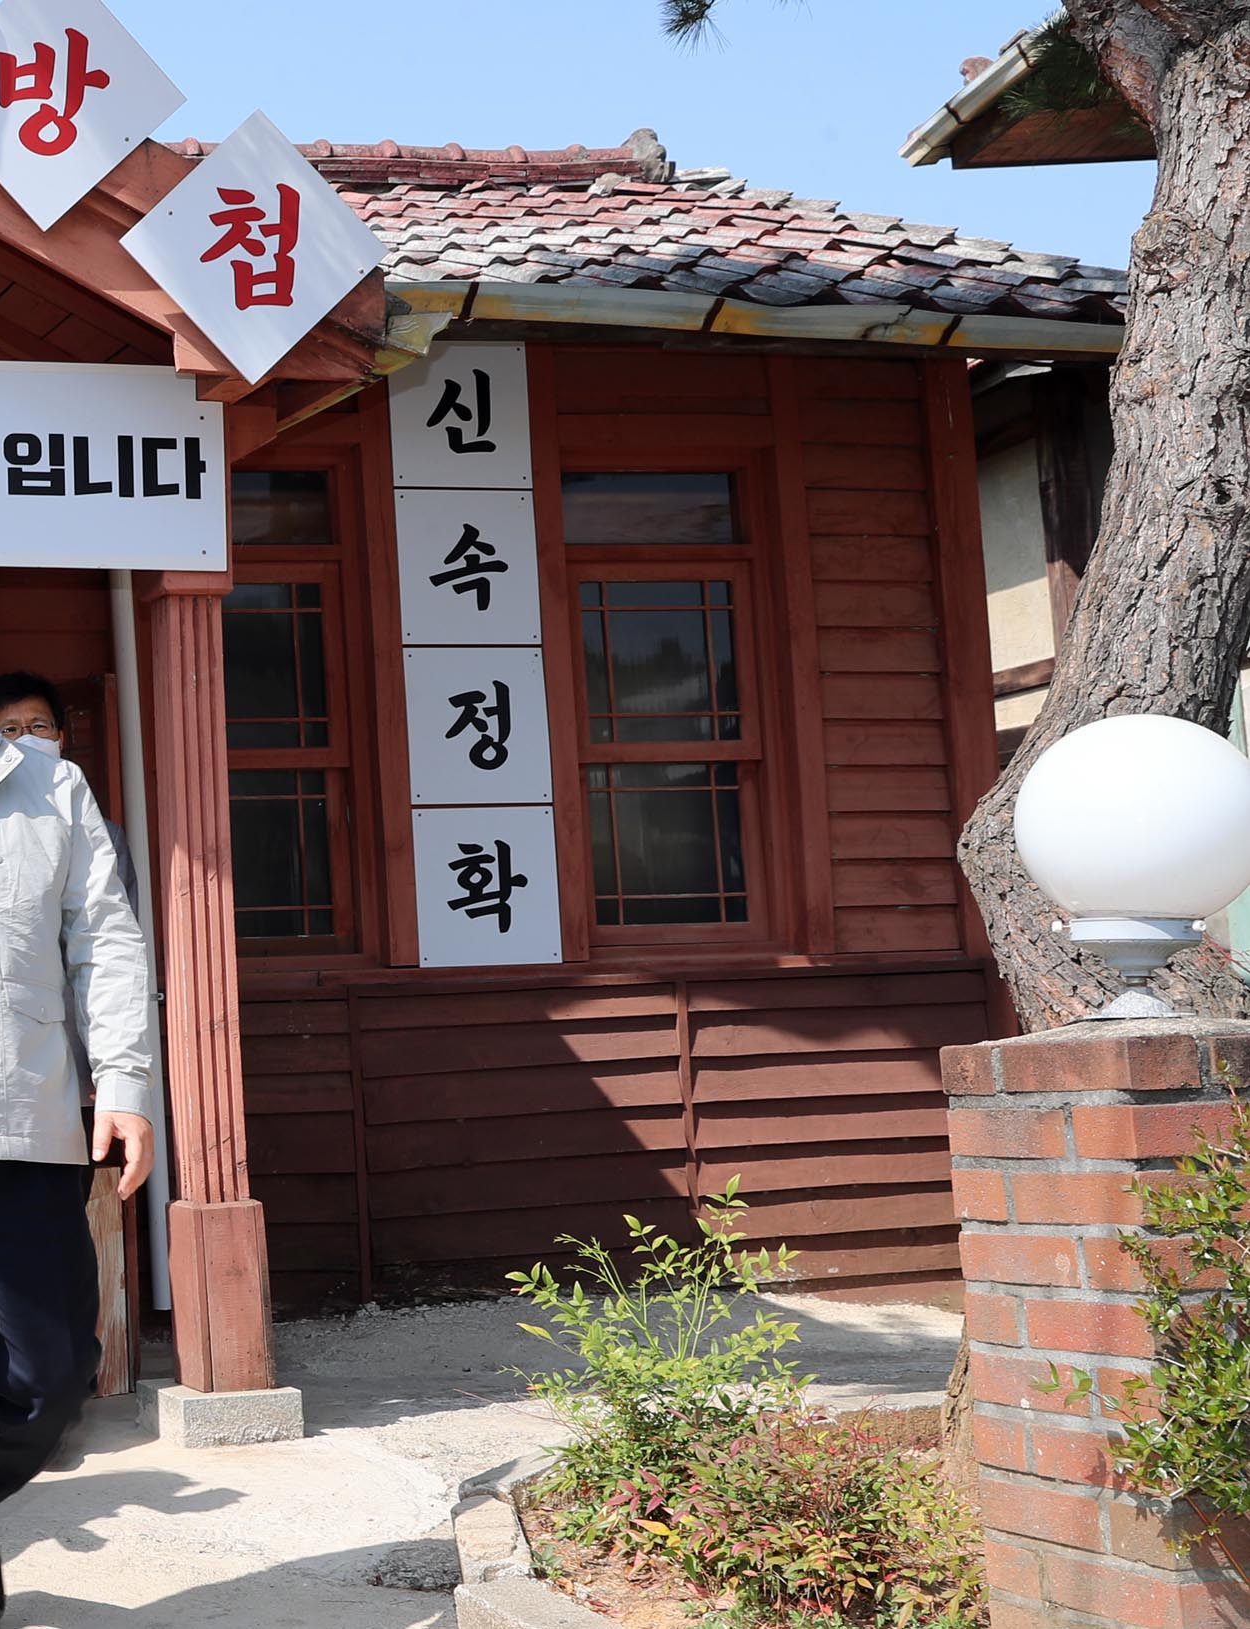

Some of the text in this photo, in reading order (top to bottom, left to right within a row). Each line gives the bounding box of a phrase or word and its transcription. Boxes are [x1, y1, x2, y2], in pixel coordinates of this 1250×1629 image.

[200, 183, 301, 310] 첩
[426, 368, 497, 455] 신
[429, 522, 509, 612] 속
[445, 680, 512, 771] 정
[446, 839, 529, 934] 확
